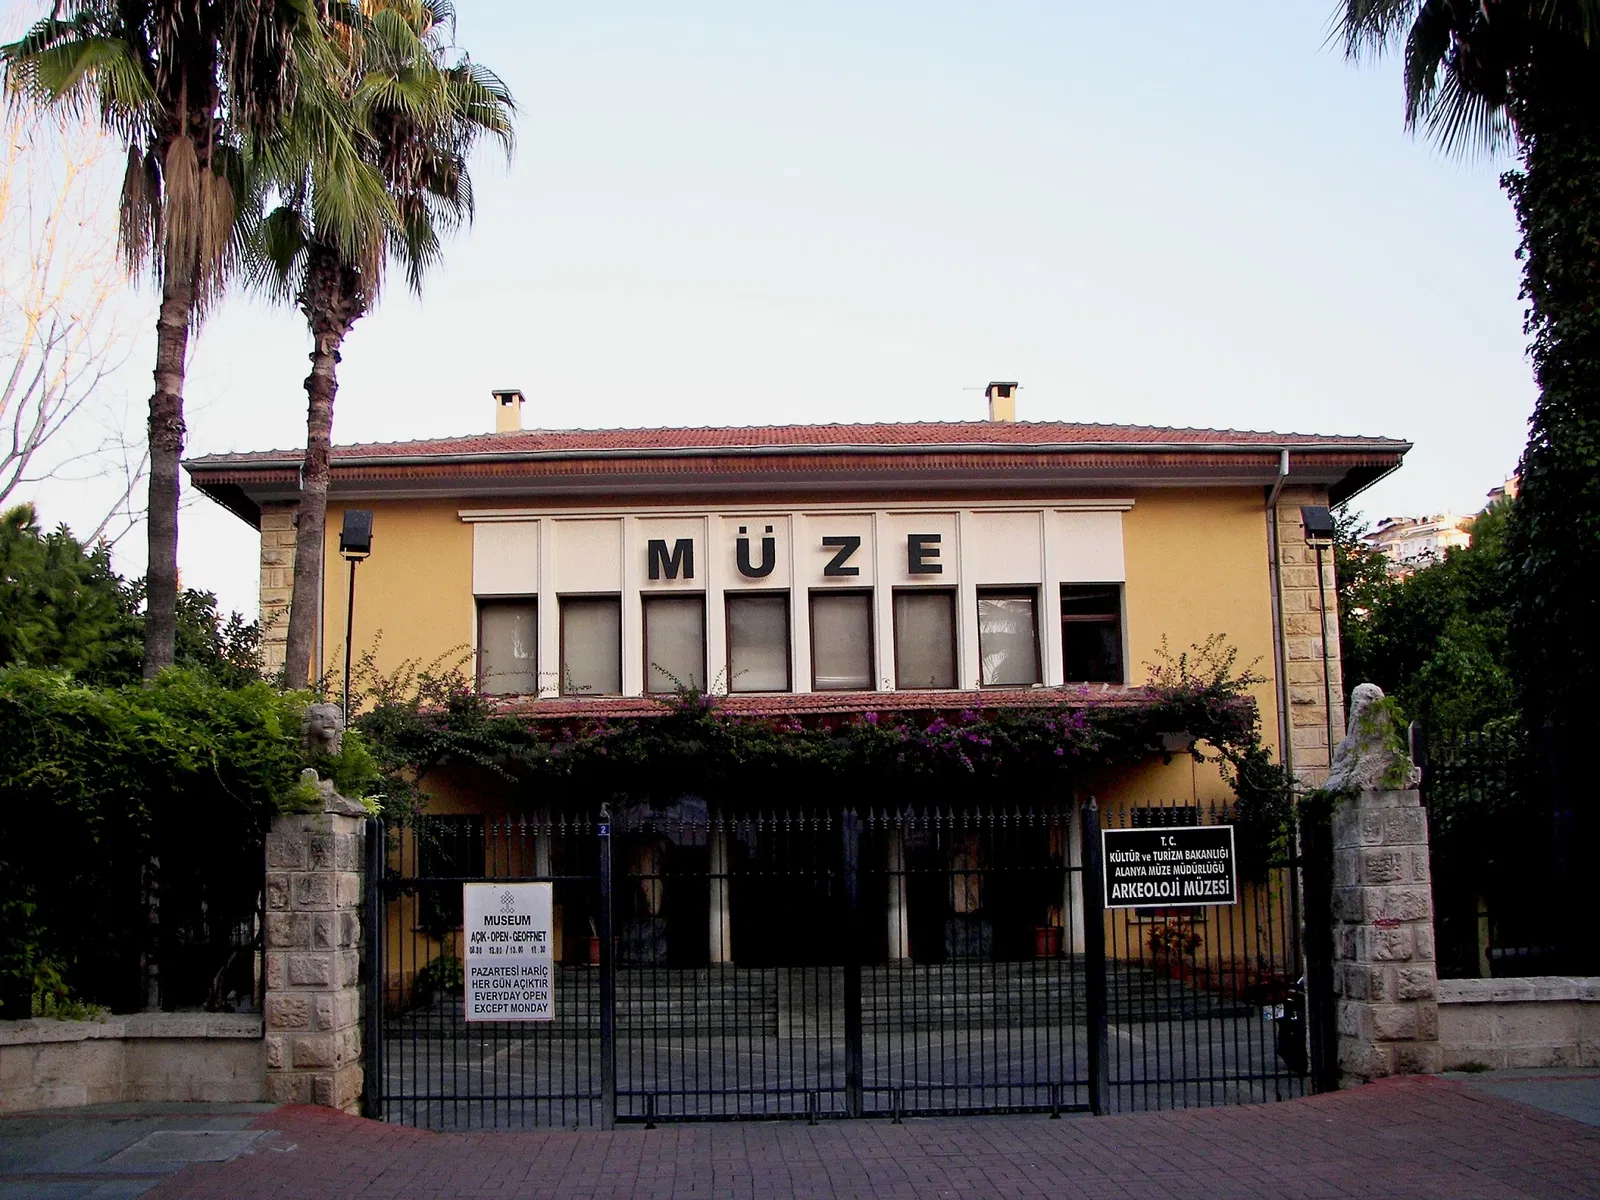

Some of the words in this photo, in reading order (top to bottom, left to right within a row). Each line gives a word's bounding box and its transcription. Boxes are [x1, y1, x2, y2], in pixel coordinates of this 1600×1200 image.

[600, 825, 607, 834] 2
[1110, 850, 1140, 862] KÜLTÜR
[1153, 848, 1183, 861] TURİZM
[1185, 847, 1228, 860] BAKANLIĞI
[1115, 866, 1146, 877] ALANYA
[1148, 863, 1171, 875] MÜZE
[1173, 861, 1224, 874] MÜDÜRLÜĞÜ
[1112, 876, 1180, 898] ARKEOLOJİ
[1184, 876, 1229, 896] MÜZESİ
[484, 916, 531, 925] MUSEUM
[472, 965, 519, 977] PAZARTESİ
[522, 965, 548, 978] HARİÇ
[472, 979, 490, 988] HER
[492, 978, 511, 988] GÜN
[514, 979, 548, 990] AÇIKTIR
[475, 992, 520, 1000] EVERYDAY
[523, 991, 547, 1000] OPEN
[475, 1004, 508, 1012] EXCEPT
[511, 1004, 548, 1012] MONDAY
